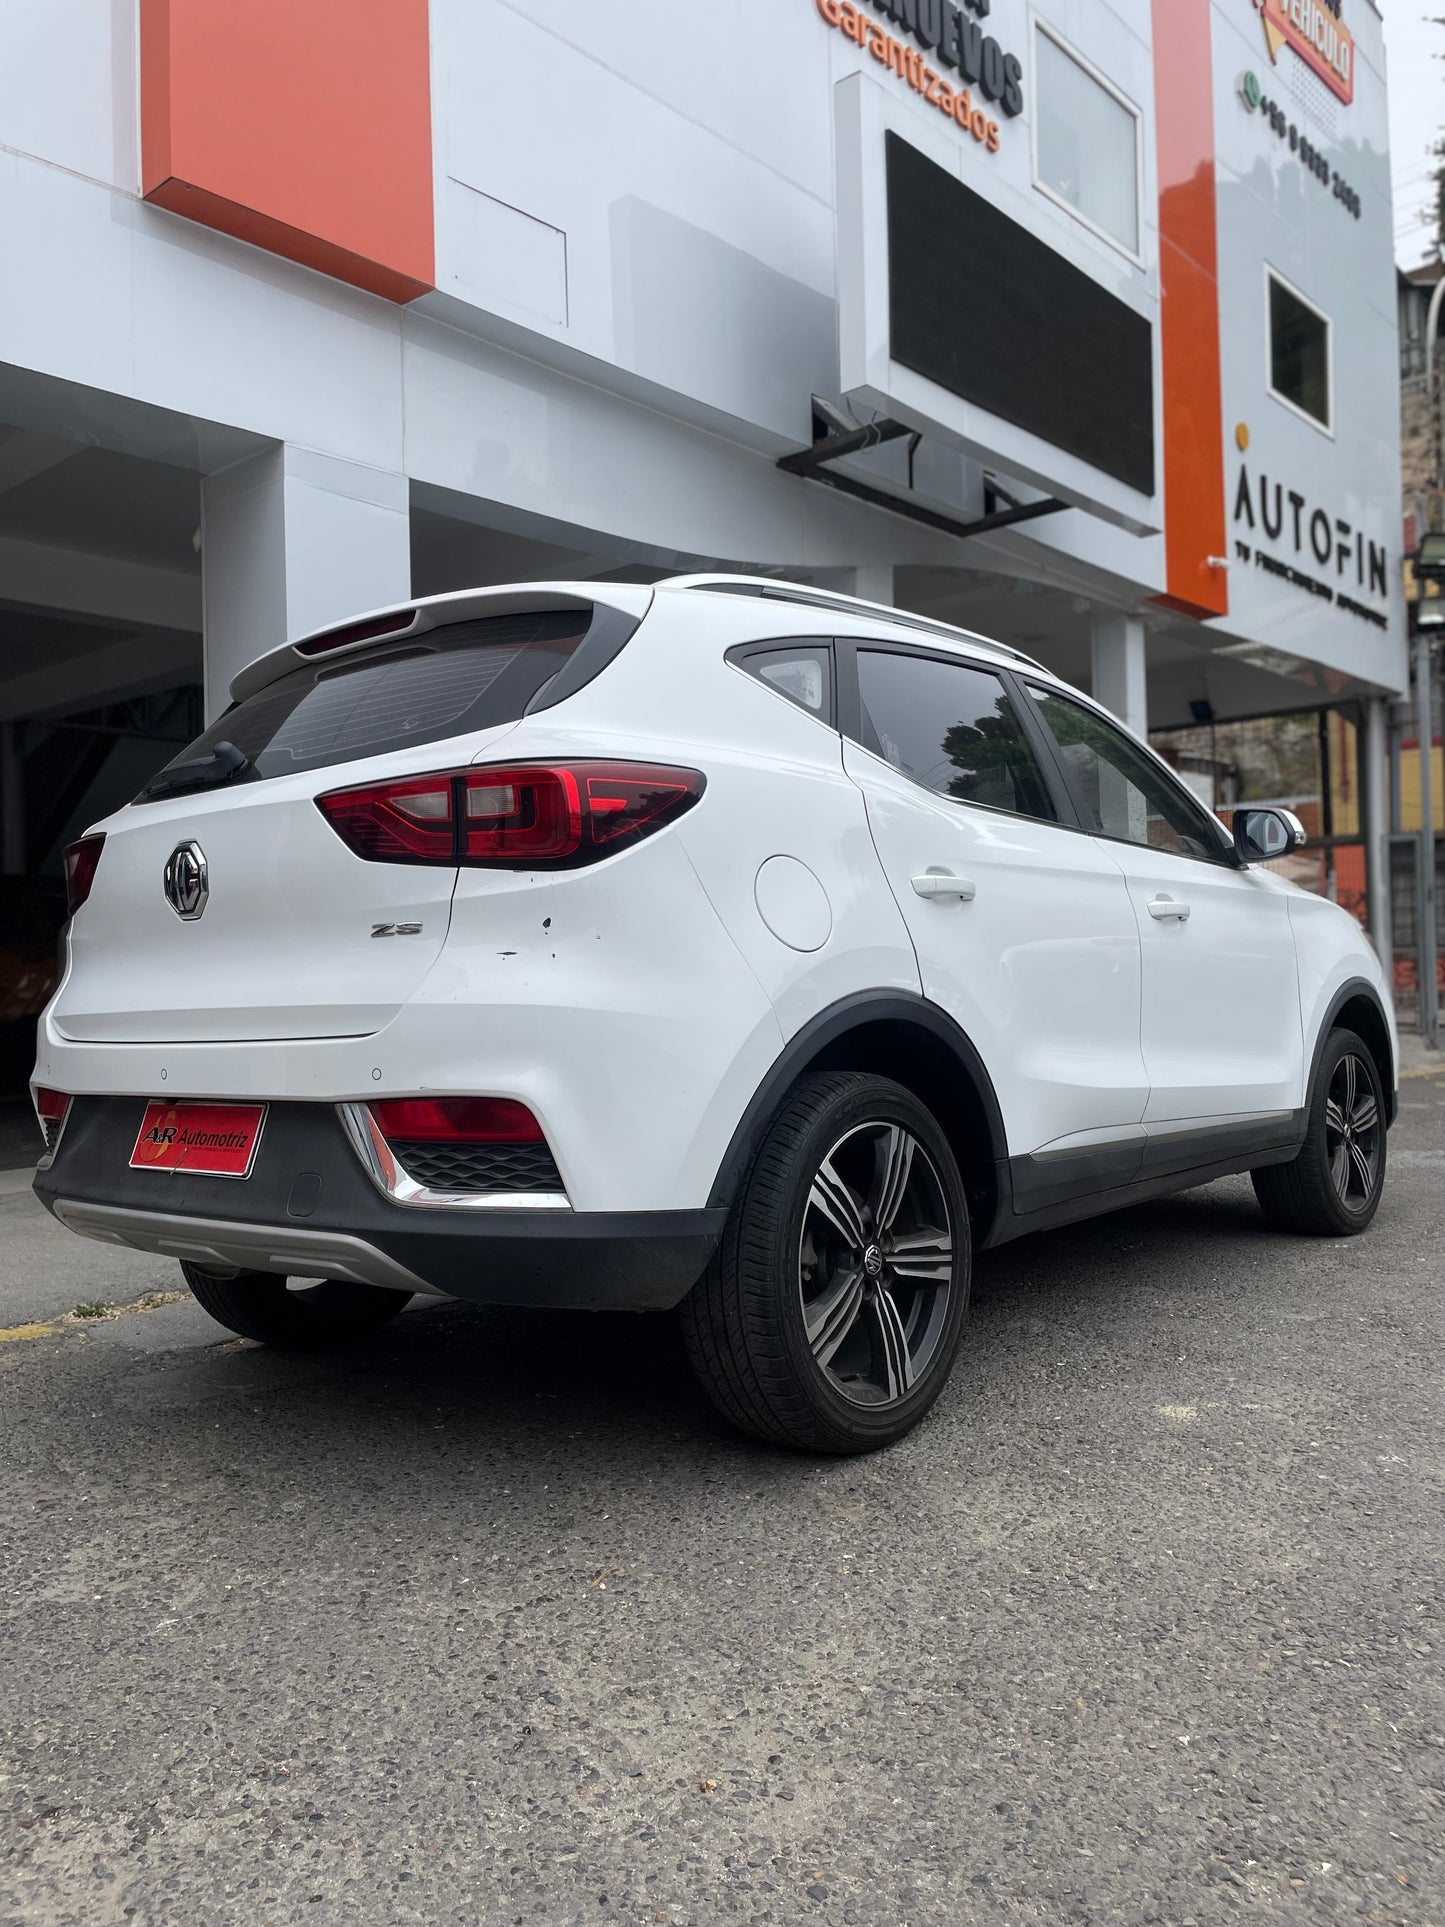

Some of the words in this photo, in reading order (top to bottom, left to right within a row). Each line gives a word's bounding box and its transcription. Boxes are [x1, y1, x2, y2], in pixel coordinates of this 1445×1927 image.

[816, 0, 1000, 153] Garantizados
[1281, 0, 1349, 83] EHICULO
[1234, 463, 1388, 599] AUTOFIN
[370, 921, 423, 938] ZS
[142, 1127, 178, 1145] A&R
[177, 1128, 249, 1149] Automotriz
